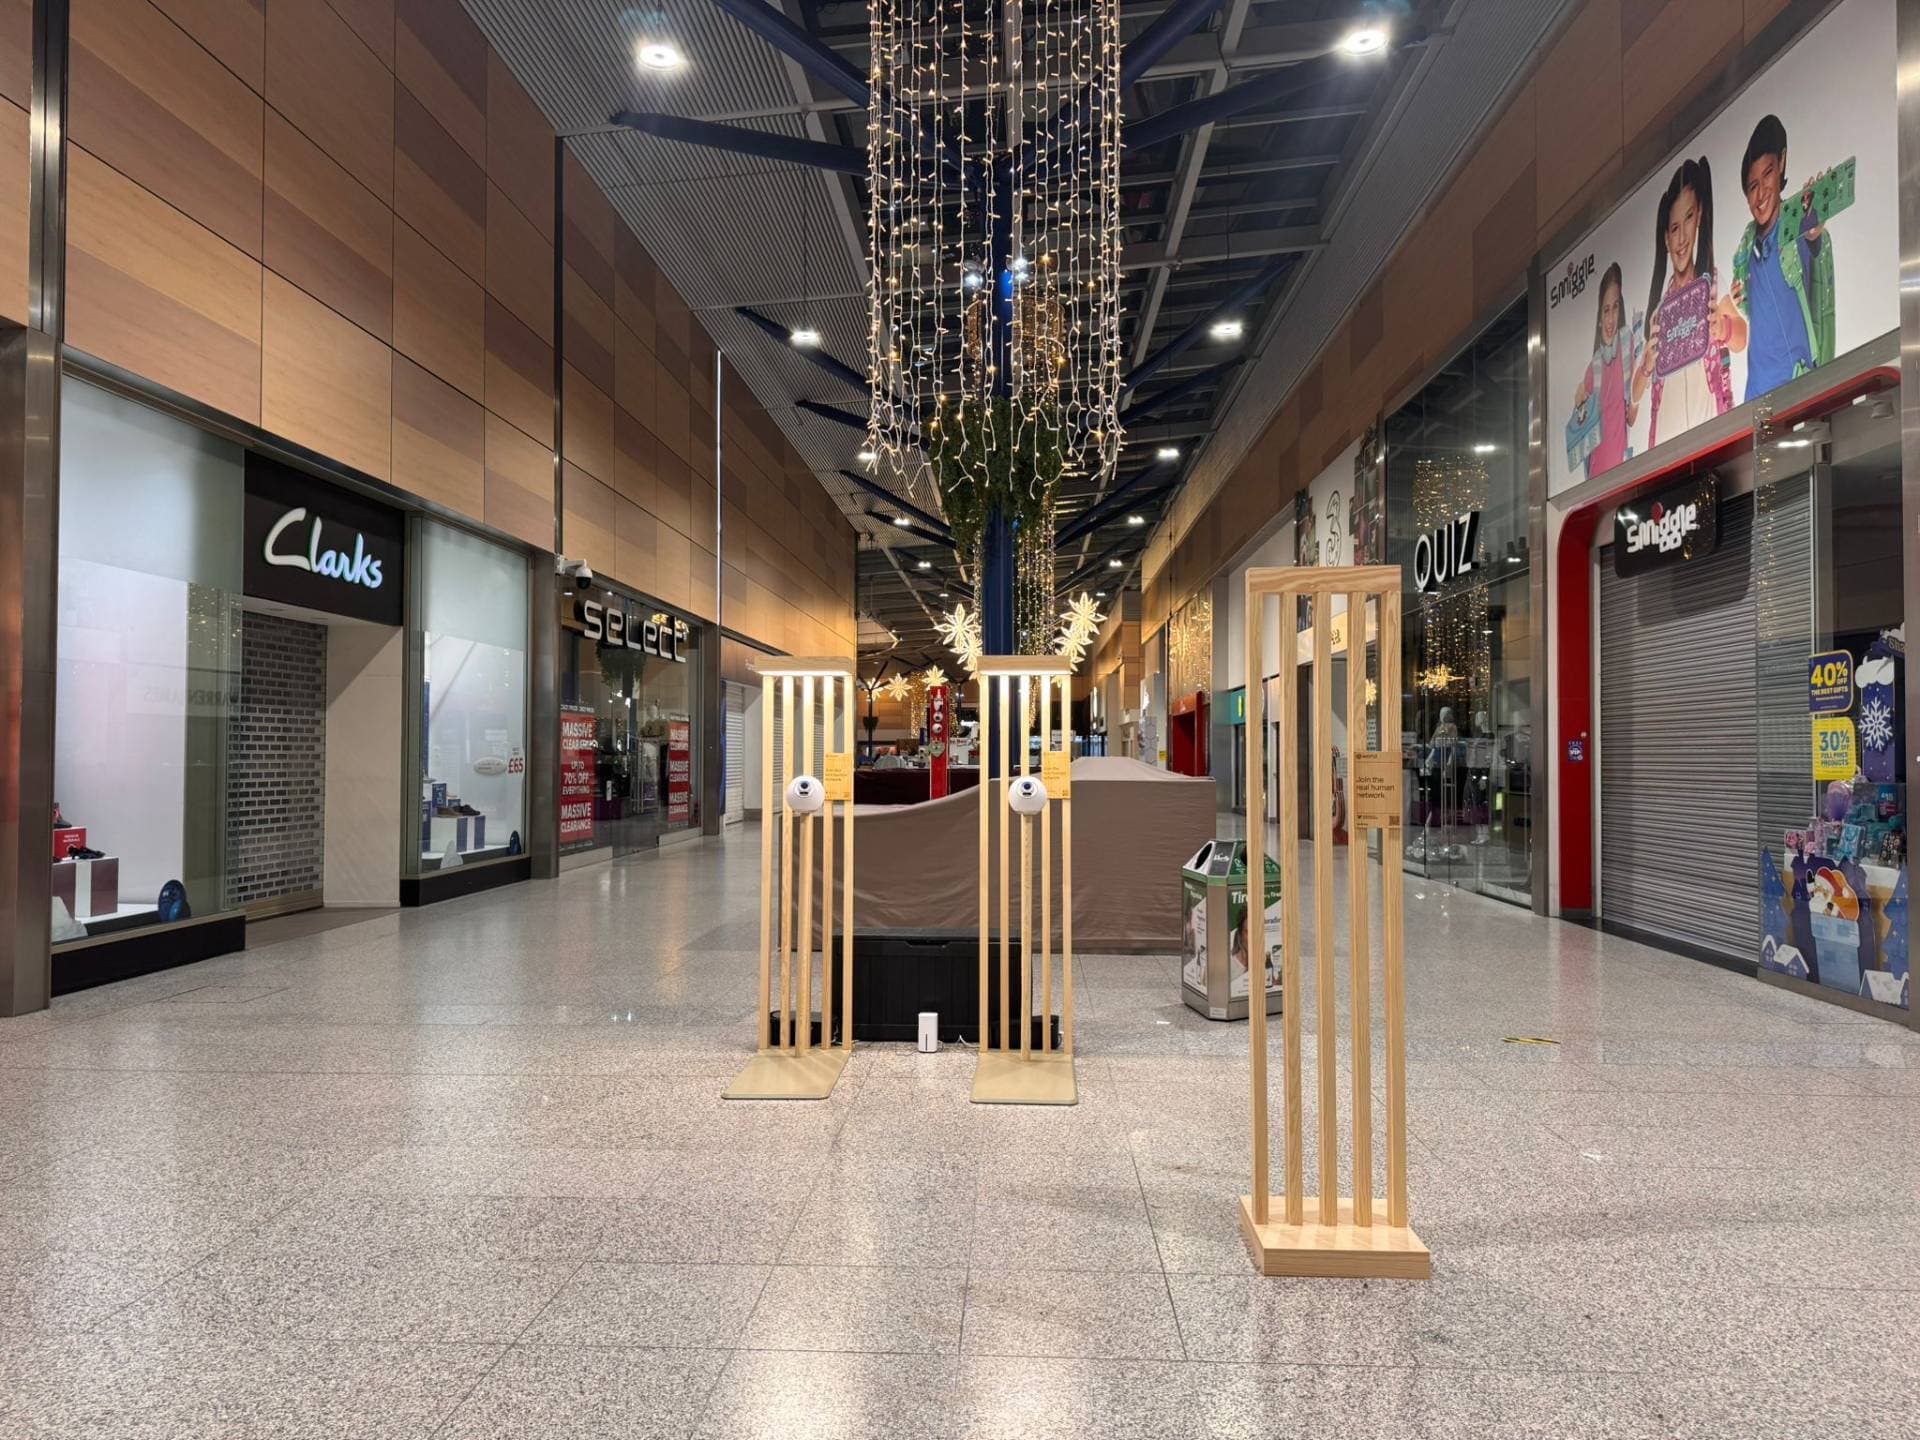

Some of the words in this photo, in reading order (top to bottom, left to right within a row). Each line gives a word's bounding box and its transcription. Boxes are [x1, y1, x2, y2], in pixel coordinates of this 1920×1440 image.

[1550, 252, 1596, 309] smiggle
[1626, 503, 1697, 553] smiggle
[264, 507, 384, 589] Clarks
[1414, 511, 1474, 593] QUIZ
[1811, 661, 1848, 688] 40%
[562, 722, 593, 738] MASSIVE
[1819, 730, 1849, 752] 30%
[508, 758, 524, 774] £65
[564, 773, 577, 785] 70%
[578, 773, 590, 784] OFF
[561, 802, 591, 819] MASSIVE
[561, 819, 591, 832] CLEARANCE
